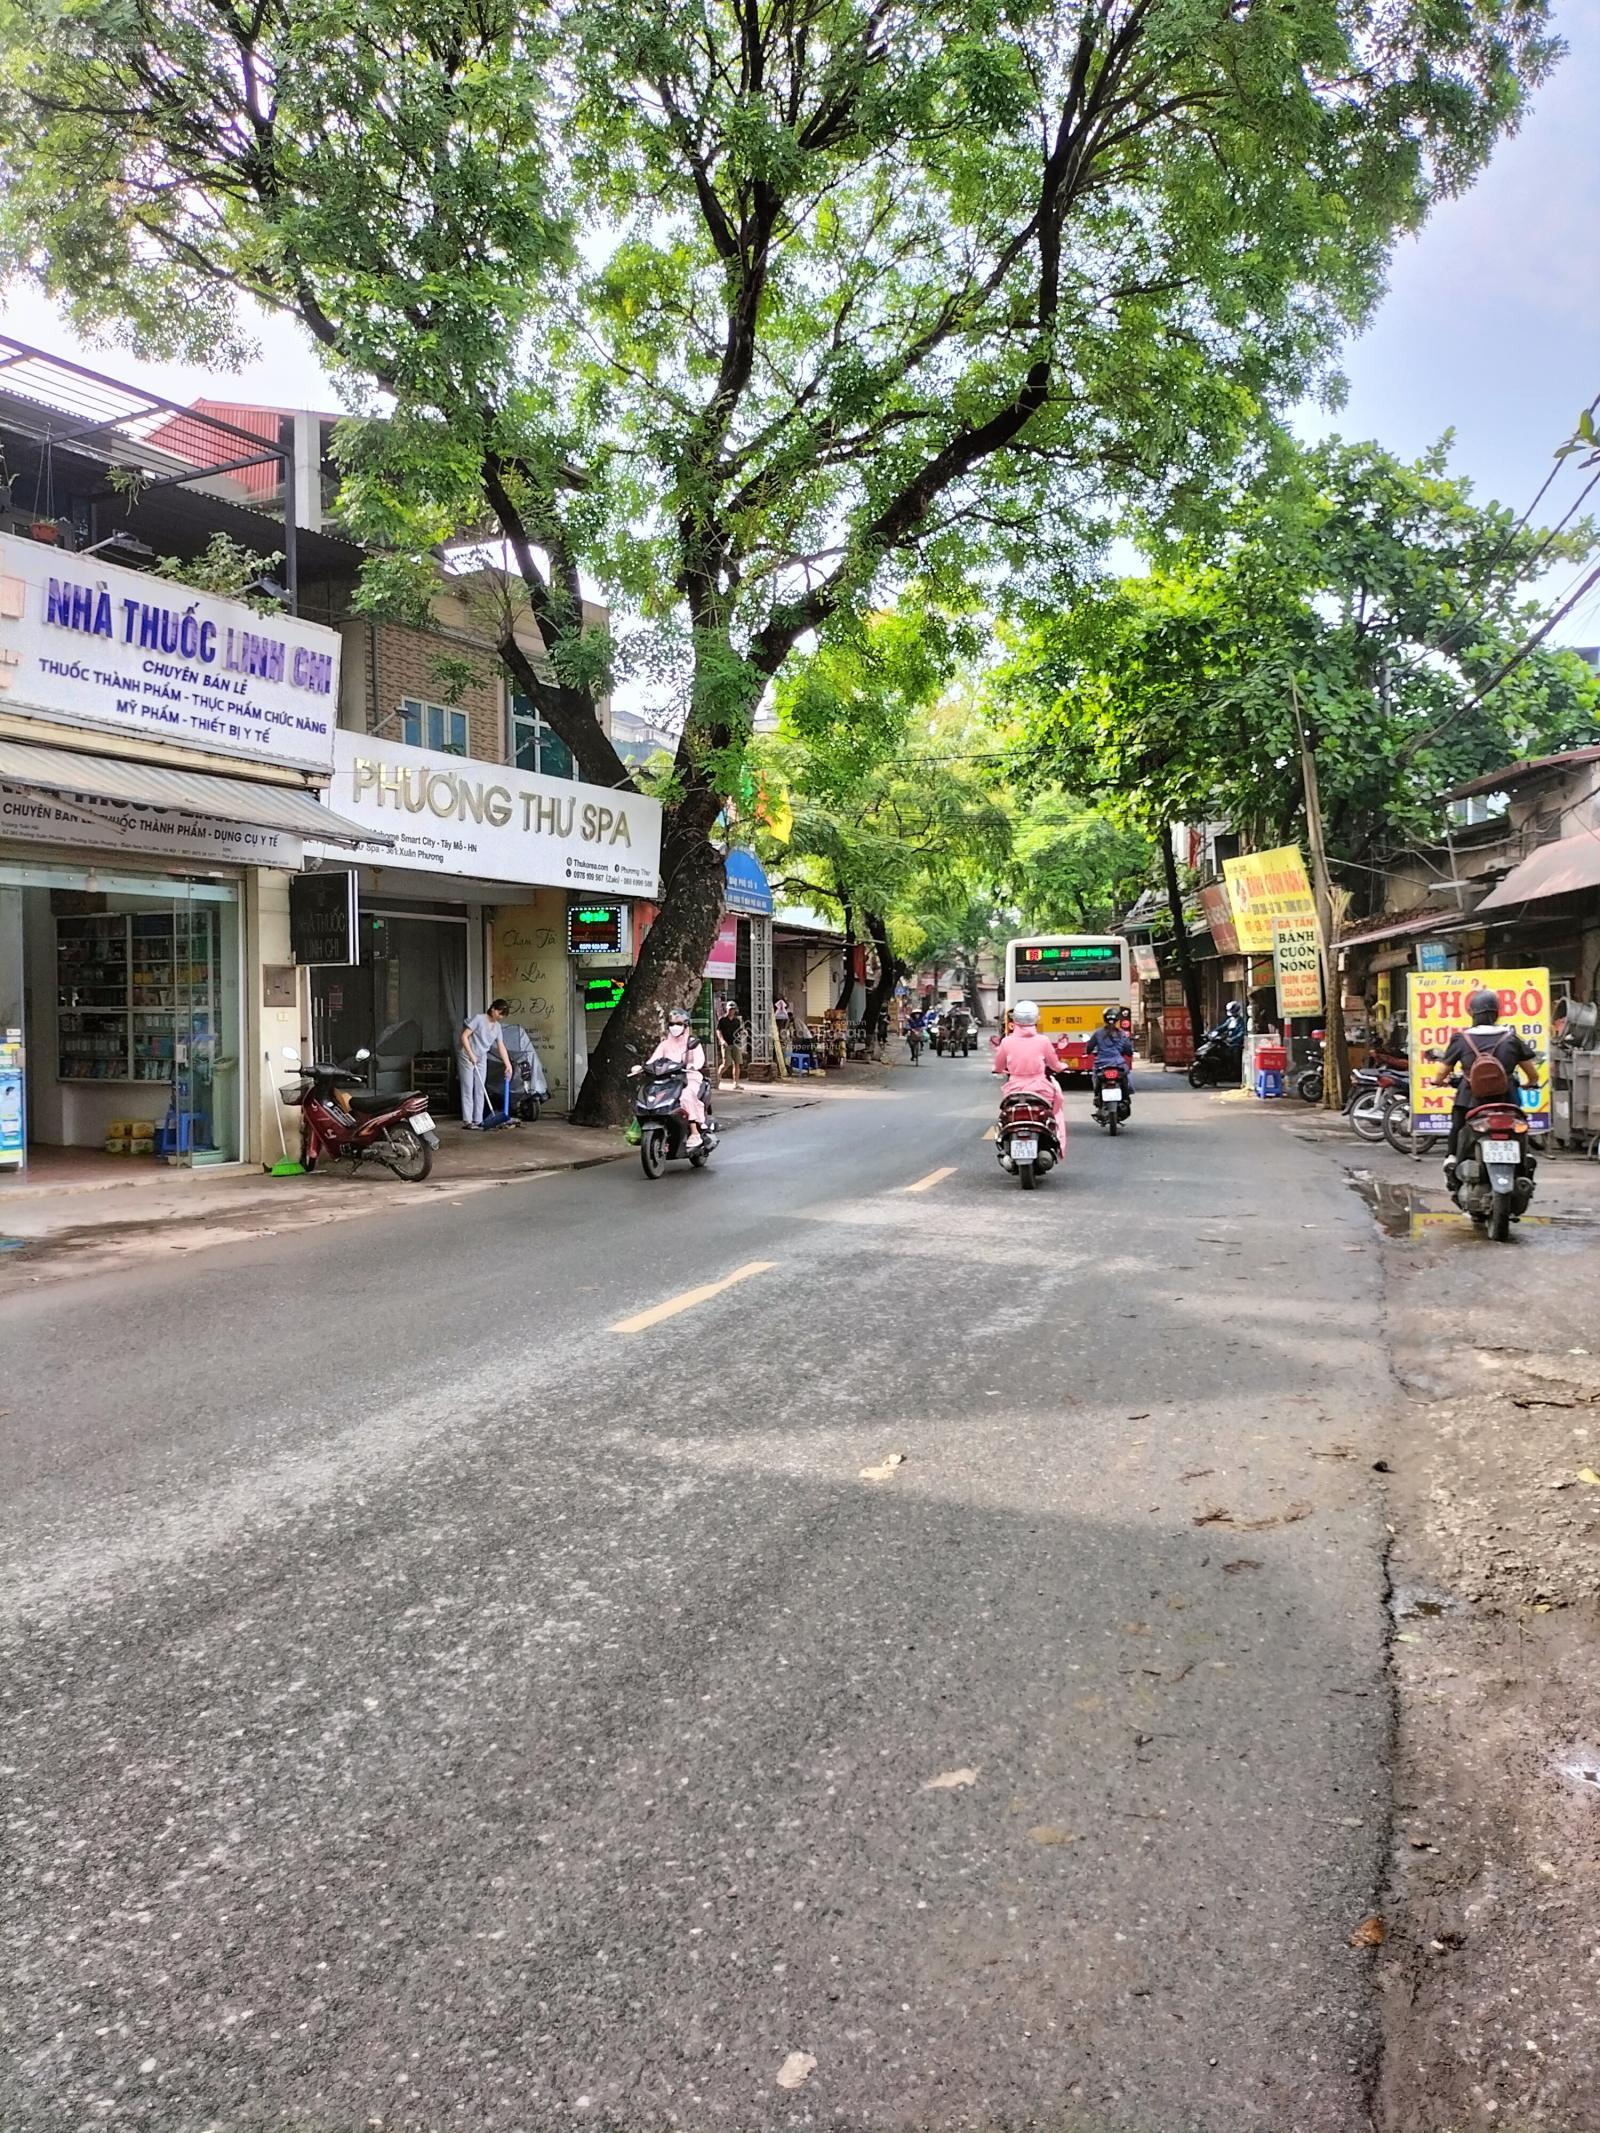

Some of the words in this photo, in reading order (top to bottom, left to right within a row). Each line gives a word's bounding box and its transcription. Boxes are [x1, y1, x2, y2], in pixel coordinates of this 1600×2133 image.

[47, 577, 113, 638] NHÀ
[123, 601, 217, 663] THUỐC
[226, 627, 286, 683] LINH
[293, 646, 332, 694] CHI
[38, 658, 90, 682] THUỐC
[93, 671, 141, 693] THÀNH
[192, 693, 225, 712] THỰC
[264, 711, 294, 727] CHỨC
[296, 717, 327, 734] NĂNG
[142, 660, 199, 684] CHUYÊN
[203, 673, 232, 691] BÁN
[190, 716, 226, 734] THIẾT
[229, 724, 241, 740] BỊ
[243, 727, 252, 741] Y
[255, 727, 271, 744] TẾ
[353, 757, 513, 827] PHƯƠNG
[519, 791, 576, 838] THƯ
[580, 803, 631, 848] SPA
[3, 802, 52, 819] CHUYÊN
[140, 818, 174, 834] THÀNH
[214, 829, 242, 844] DỤNG
[245, 833, 258, 848] CỤ
[261, 836, 267, 845] Y
[269, 833, 280, 848] TẾ
[400, 834, 422, 845] Smart
[423, 837, 435, 848] City
[467, 844, 477, 852] HN
[1496, 979, 1543, 1017] BÒ
